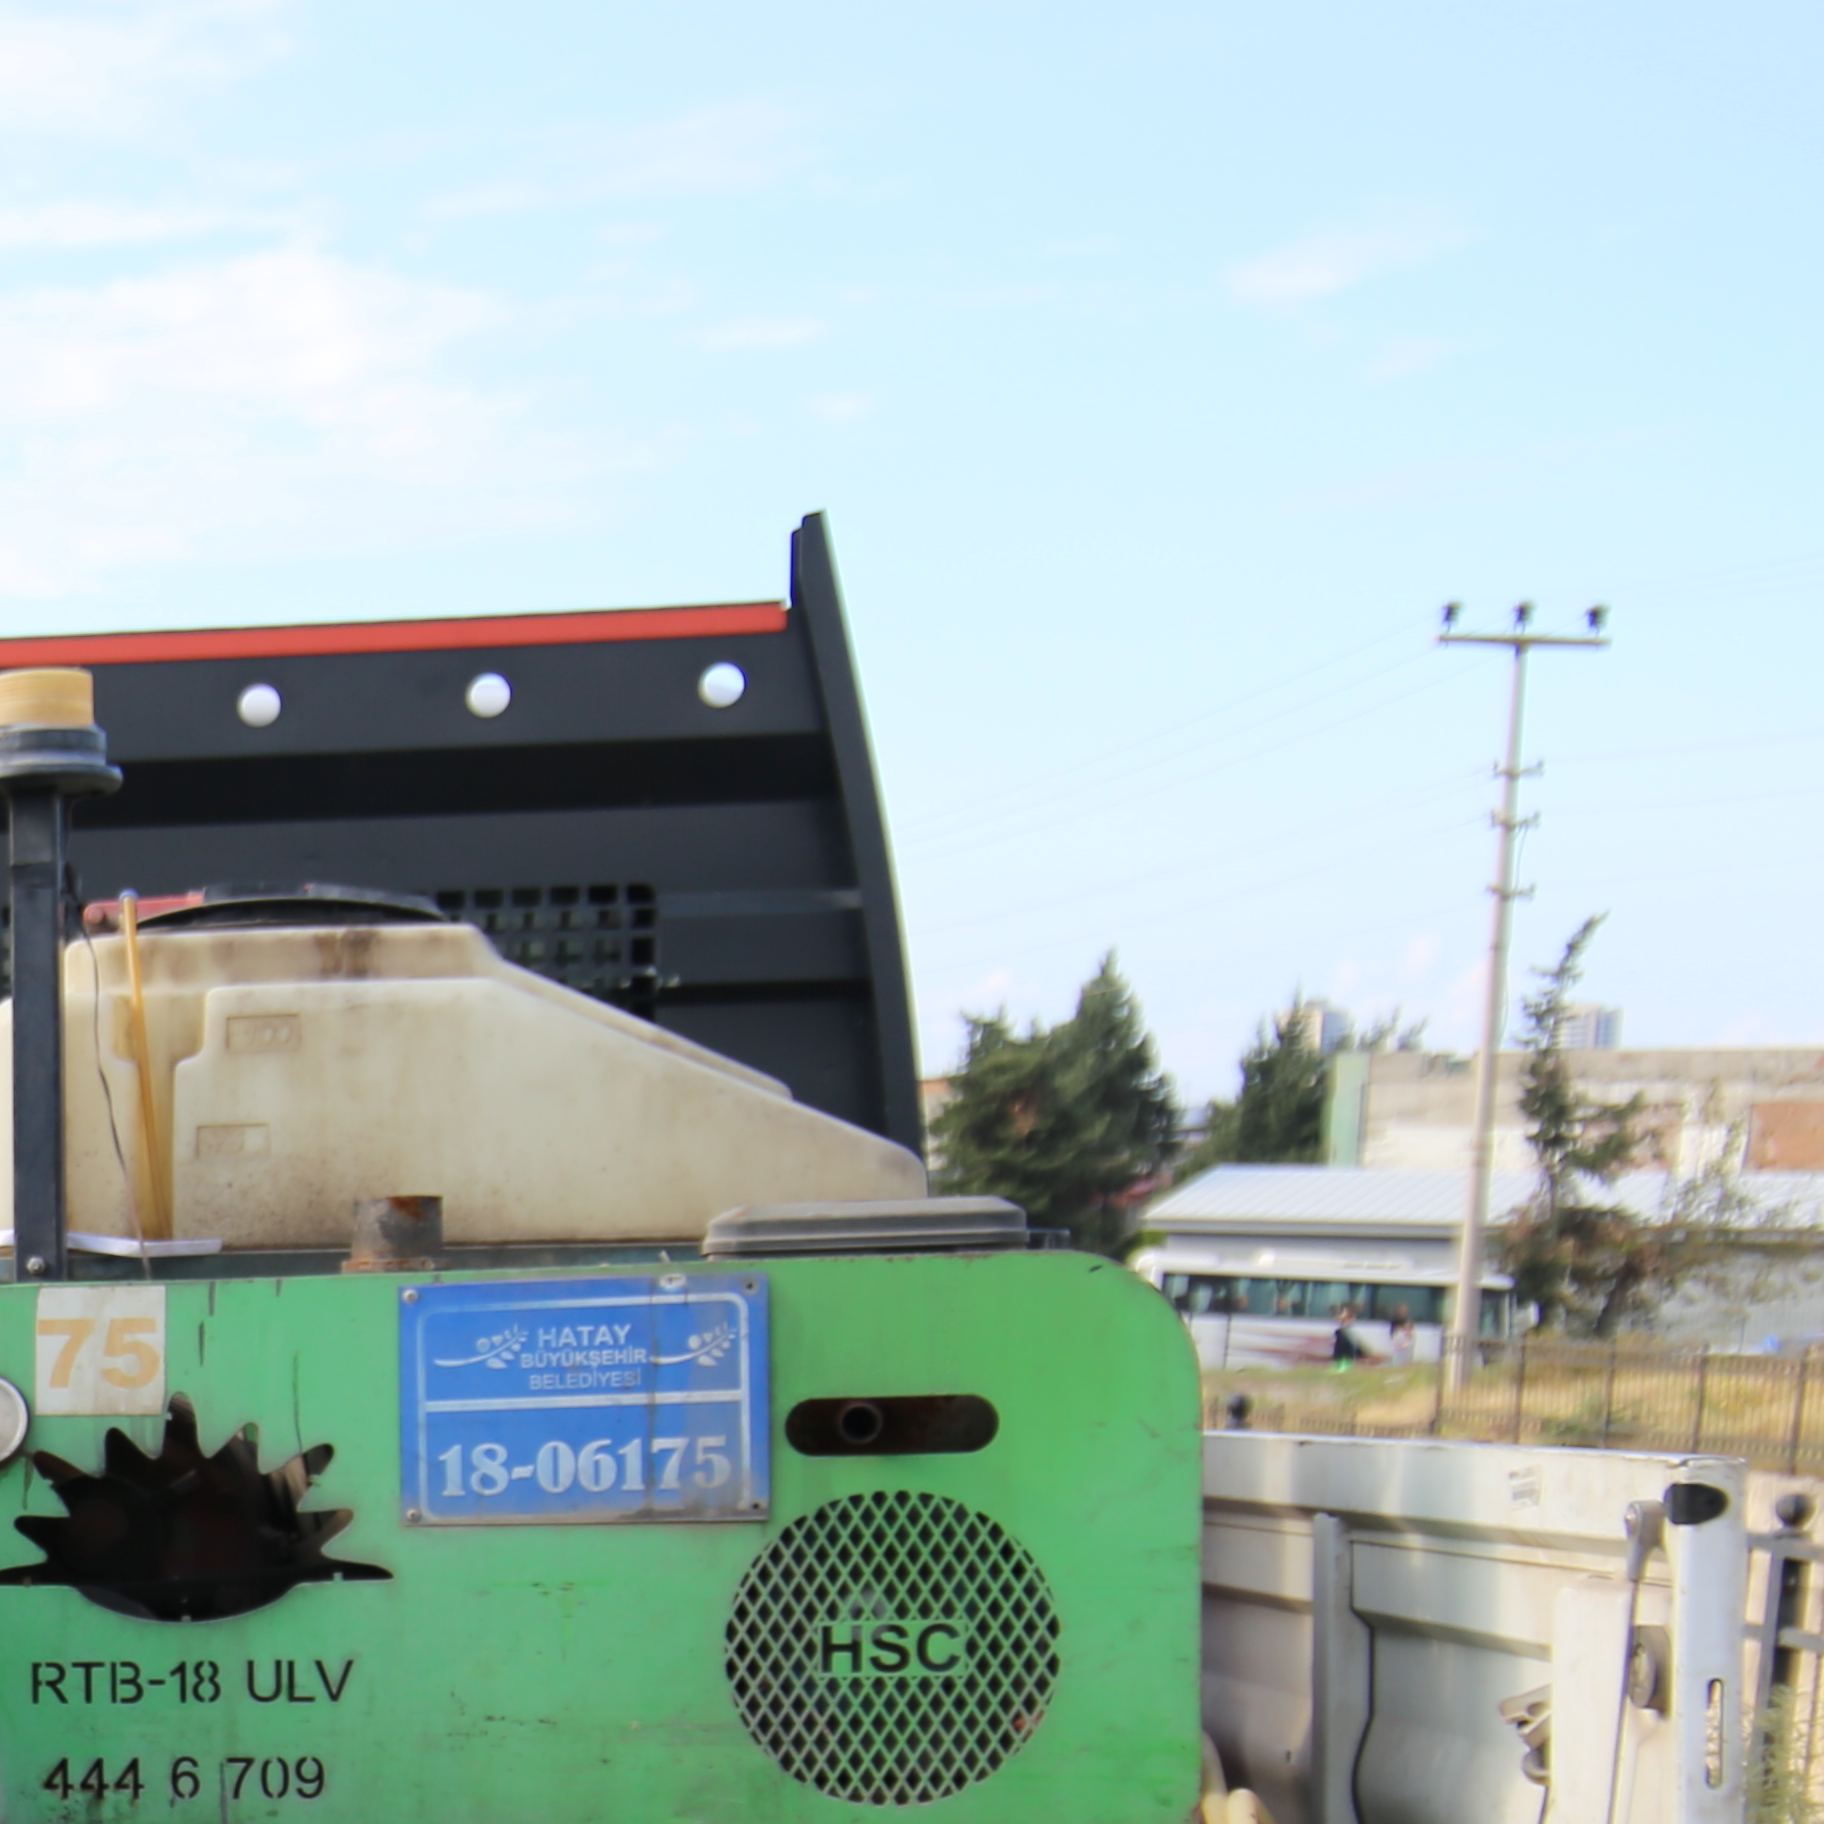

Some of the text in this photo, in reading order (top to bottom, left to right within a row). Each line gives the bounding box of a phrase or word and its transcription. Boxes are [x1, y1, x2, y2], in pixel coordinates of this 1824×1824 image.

[37, 1317, 161, 1390] 75
[519, 1346, 648, 1371] BÜYÜKŞEHİR
[536, 1323, 632, 1350] HATAY
[528, 1366, 643, 1392] BELEDİYESİ
[438, 1434, 733, 1498] 18-06175
[820, 1622, 961, 1674] HSC
[30, 1658, 355, 1705] RTB-18 ULV
[42, 1756, 326, 1801] 444 6 709
